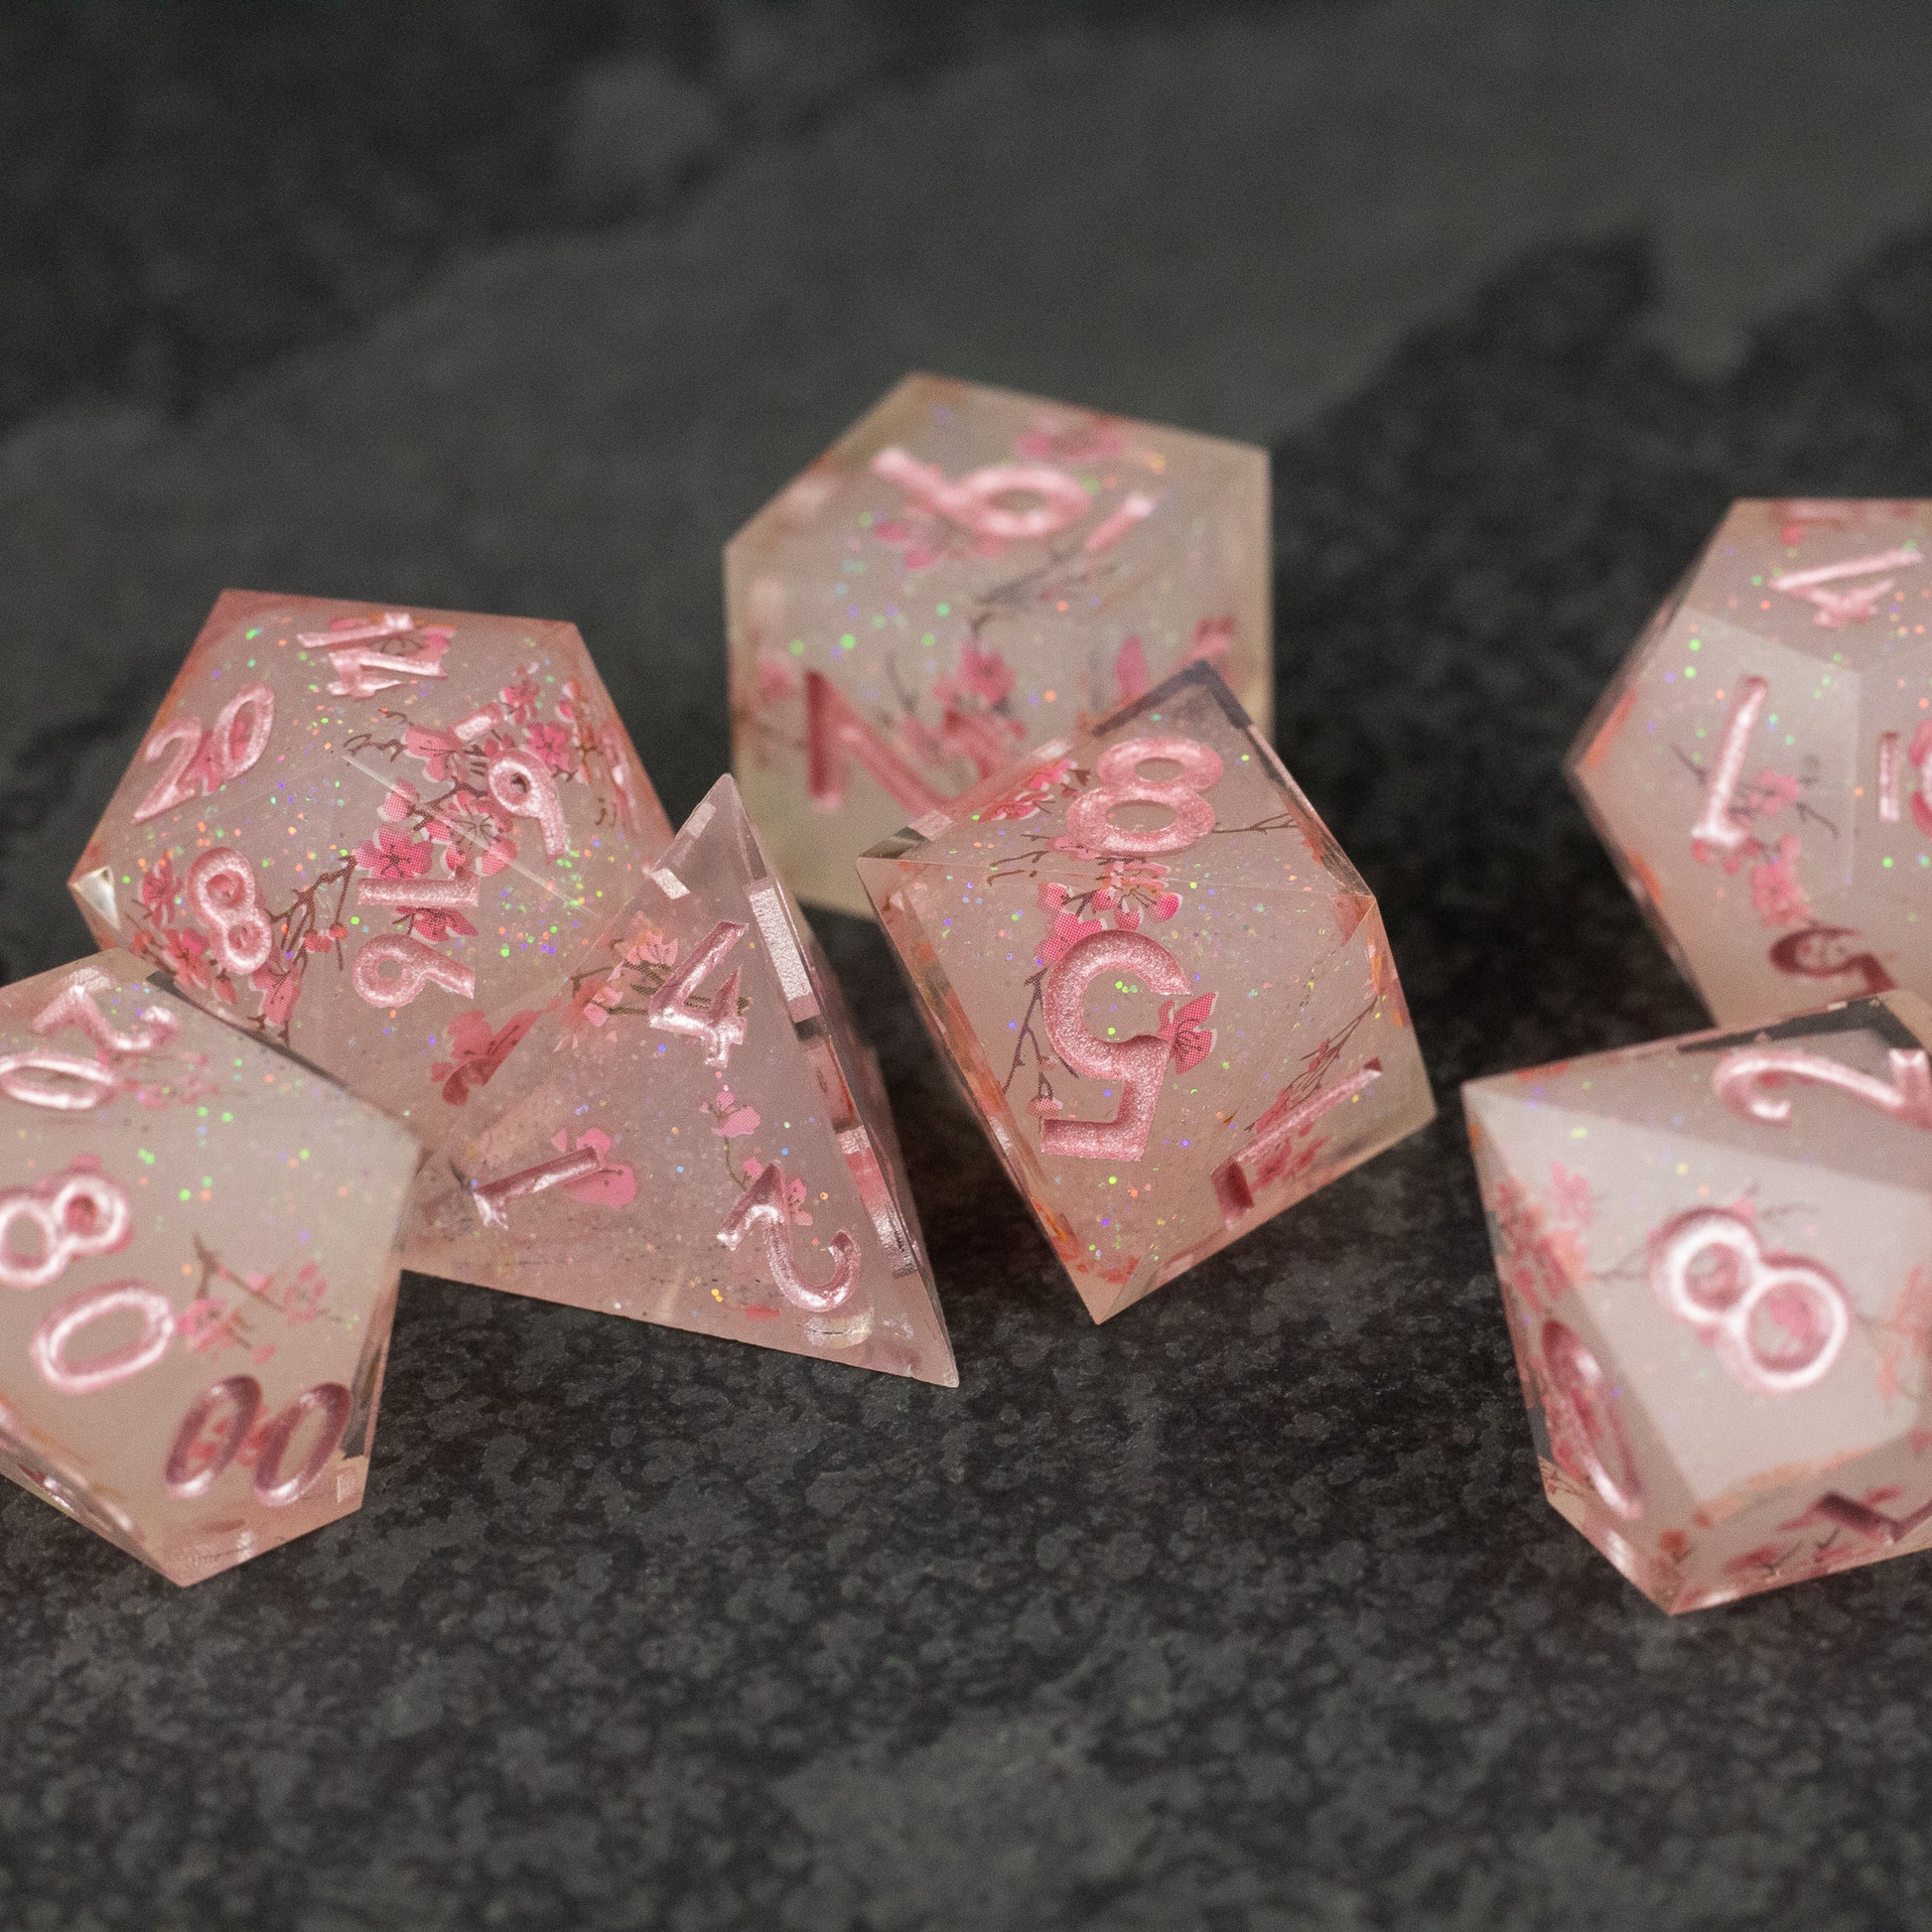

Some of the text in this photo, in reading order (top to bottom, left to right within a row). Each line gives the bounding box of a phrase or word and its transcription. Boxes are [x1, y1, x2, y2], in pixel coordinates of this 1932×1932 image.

[132, 683, 275, 825] 20
[1066, 735, 1224, 856] 8
[187, 846, 275, 976] 8
[648, 919, 748, 1068] 4
[1040, 929, 1191, 1162] 5
[717, 1162, 863, 1312] 2
[1648, 1206, 1850, 1396] 8
[163, 1373, 352, 1508] 00
